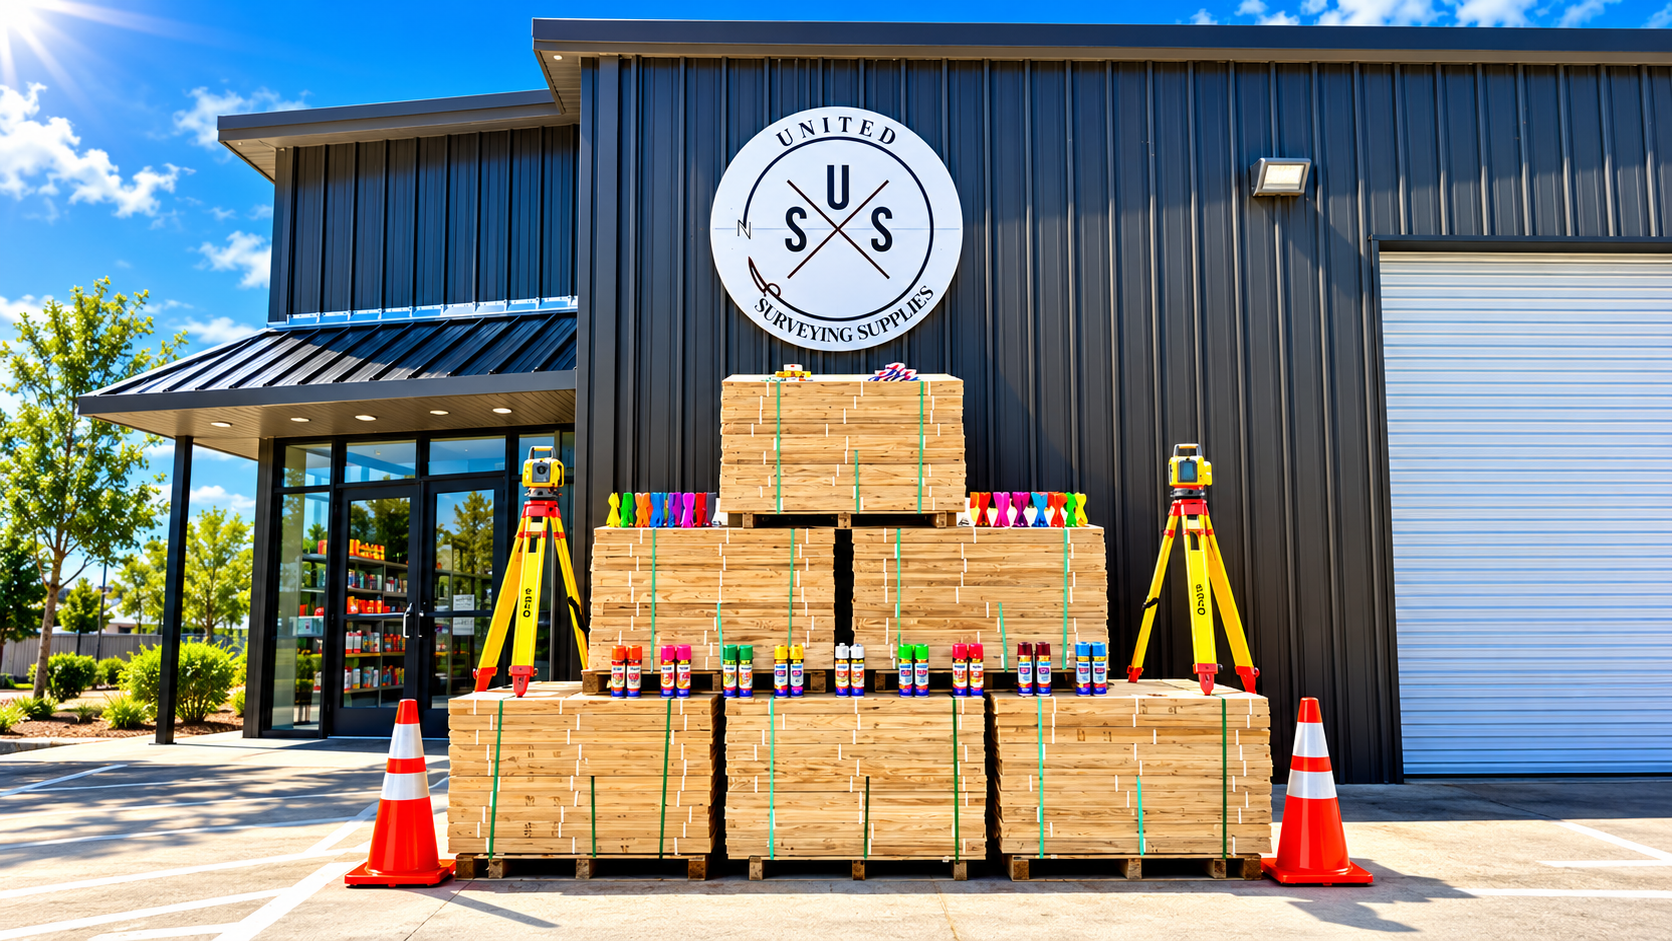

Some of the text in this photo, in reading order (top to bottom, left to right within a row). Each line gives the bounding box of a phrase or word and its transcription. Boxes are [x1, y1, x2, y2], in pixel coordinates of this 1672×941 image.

[776, 116, 896, 148] UNITED
[827, 165, 849, 210] U
[754, 285, 934, 343] SURVEYING SUPPLIES
